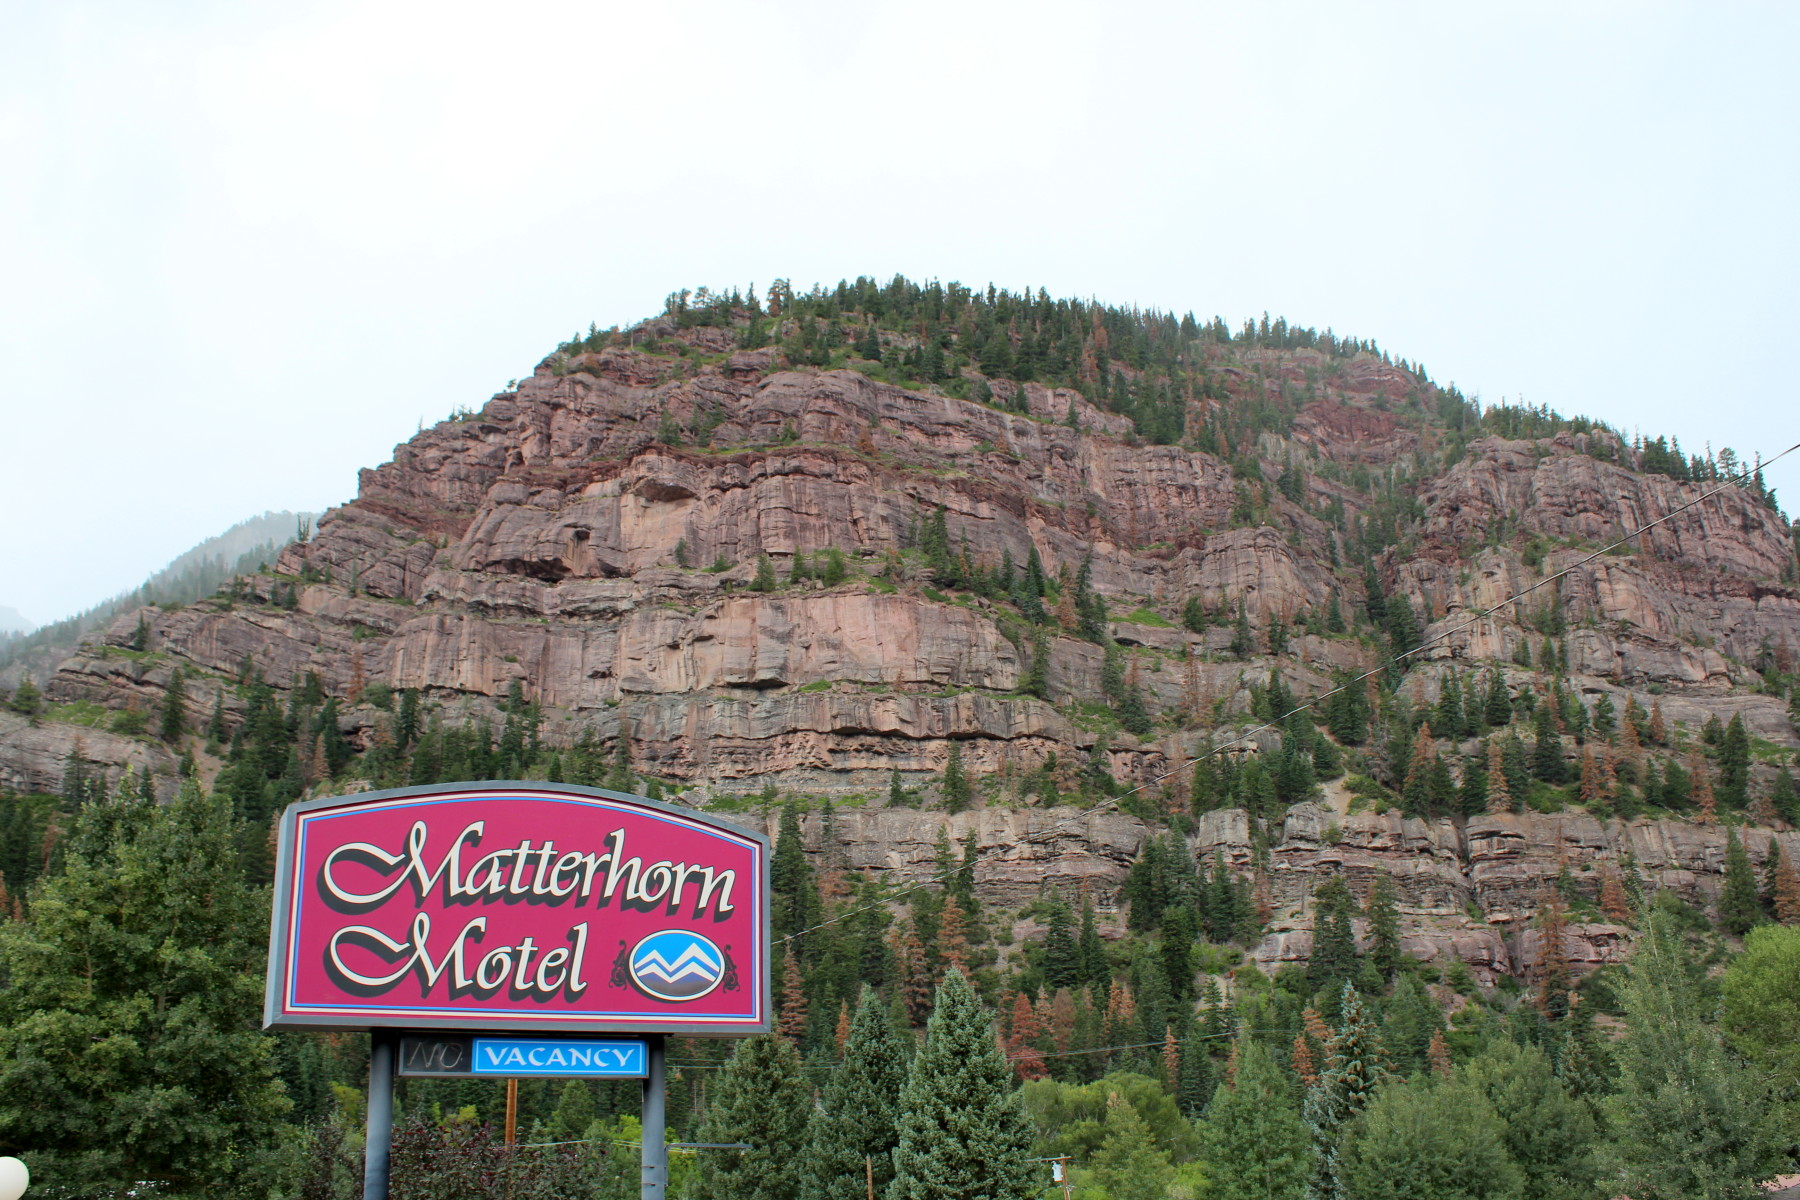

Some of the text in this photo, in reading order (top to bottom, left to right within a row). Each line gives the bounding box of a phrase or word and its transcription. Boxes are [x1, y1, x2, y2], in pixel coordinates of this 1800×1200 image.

[323, 819, 736, 913] Matterhorn
[329, 911, 589, 993] Motel
[484, 1046, 635, 1069] VACANCY
